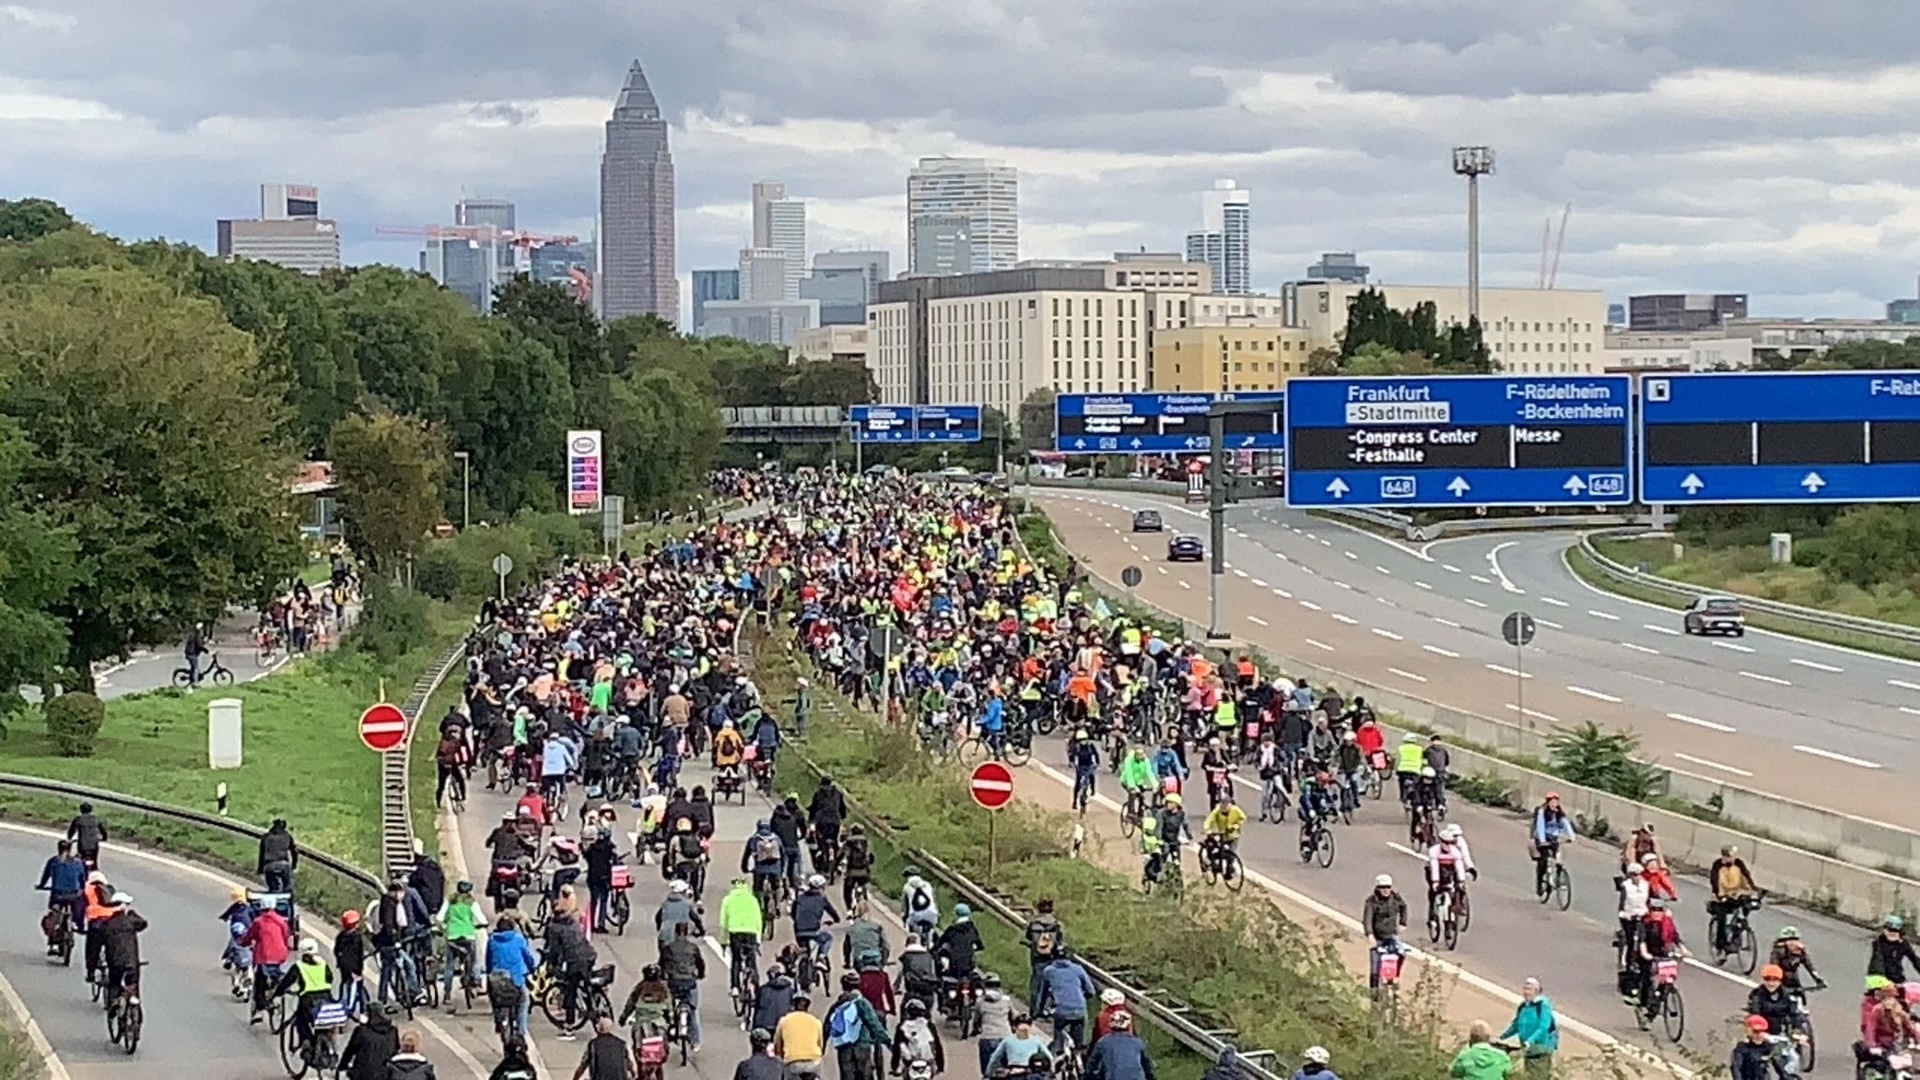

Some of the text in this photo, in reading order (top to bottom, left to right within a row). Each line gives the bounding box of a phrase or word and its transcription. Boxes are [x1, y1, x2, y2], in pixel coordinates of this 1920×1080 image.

[1347, 385, 1430, 402] Frankfurt
[1506, 384, 1611, 400] F-Rödelheim
[1349, 405, 1448, 421] -Stadtmitte
[1516, 402, 1624, 420] -Bockenheim
[1347, 428, 1479, 447] -Congress Center
[1515, 428, 1562, 443] Messe
[1347, 447, 1425, 463] -Festhalle
[1385, 480, 1412, 495] 648
[1592, 478, 1620, 493] 648
